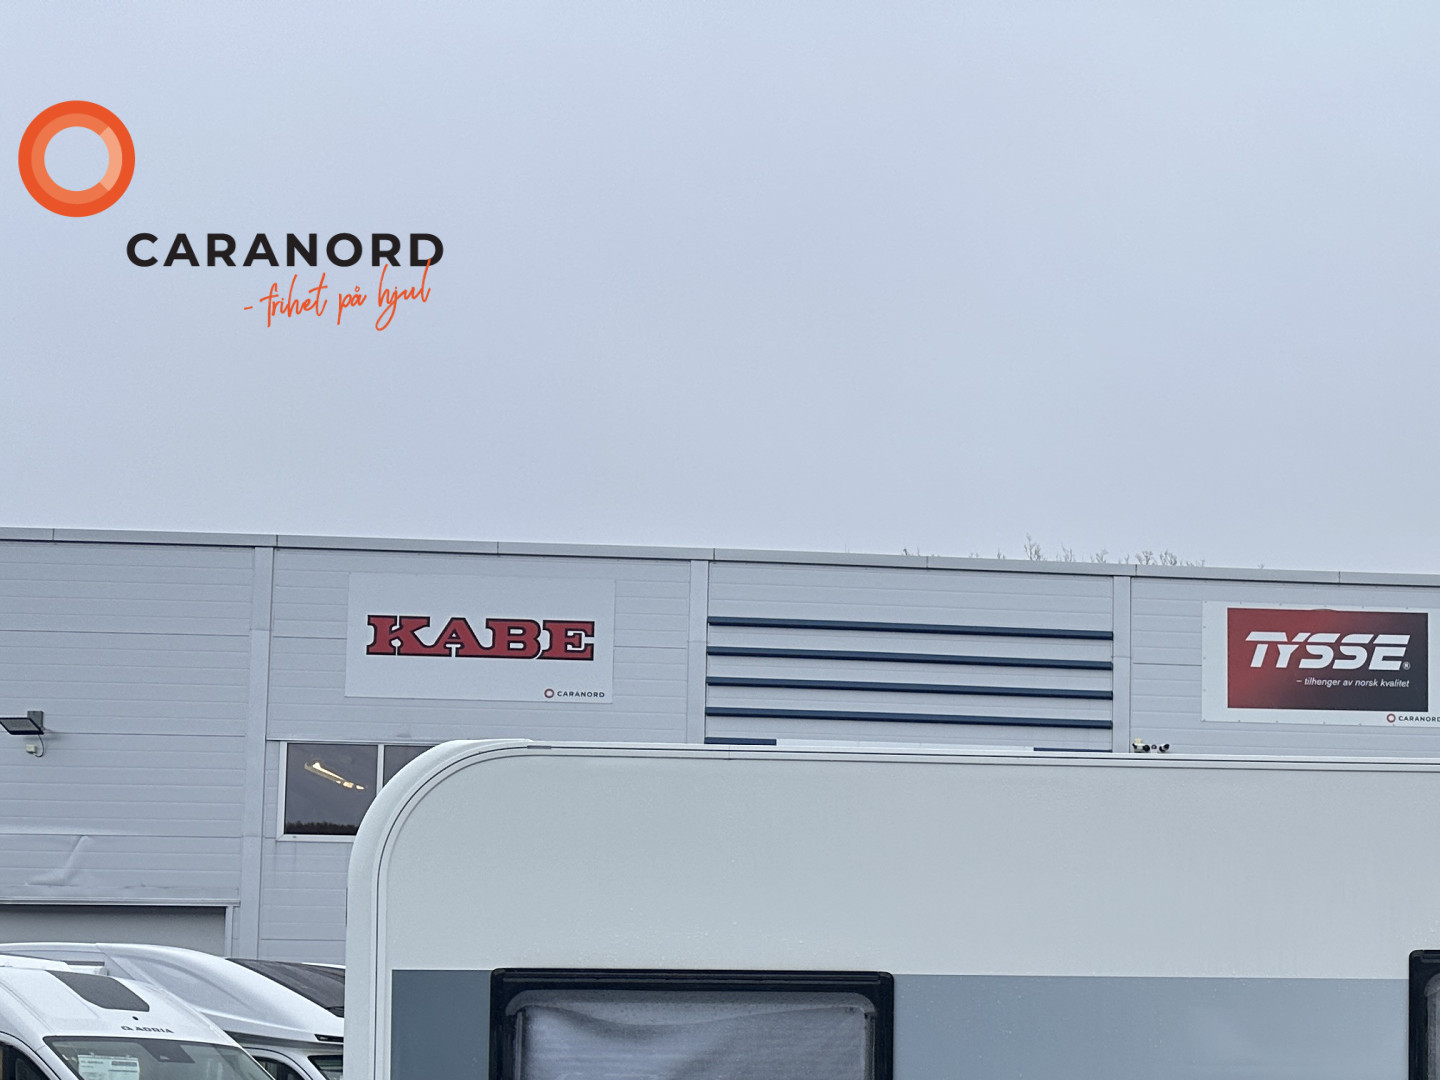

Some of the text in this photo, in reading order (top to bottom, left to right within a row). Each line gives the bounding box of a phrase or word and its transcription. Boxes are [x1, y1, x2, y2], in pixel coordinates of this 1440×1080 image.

[366, 614, 595, 661] KABE
[1355, 678, 1378, 687] norsk
[1380, 678, 1410, 687] kvalitet
[556, 690, 605, 698] CARANORD
